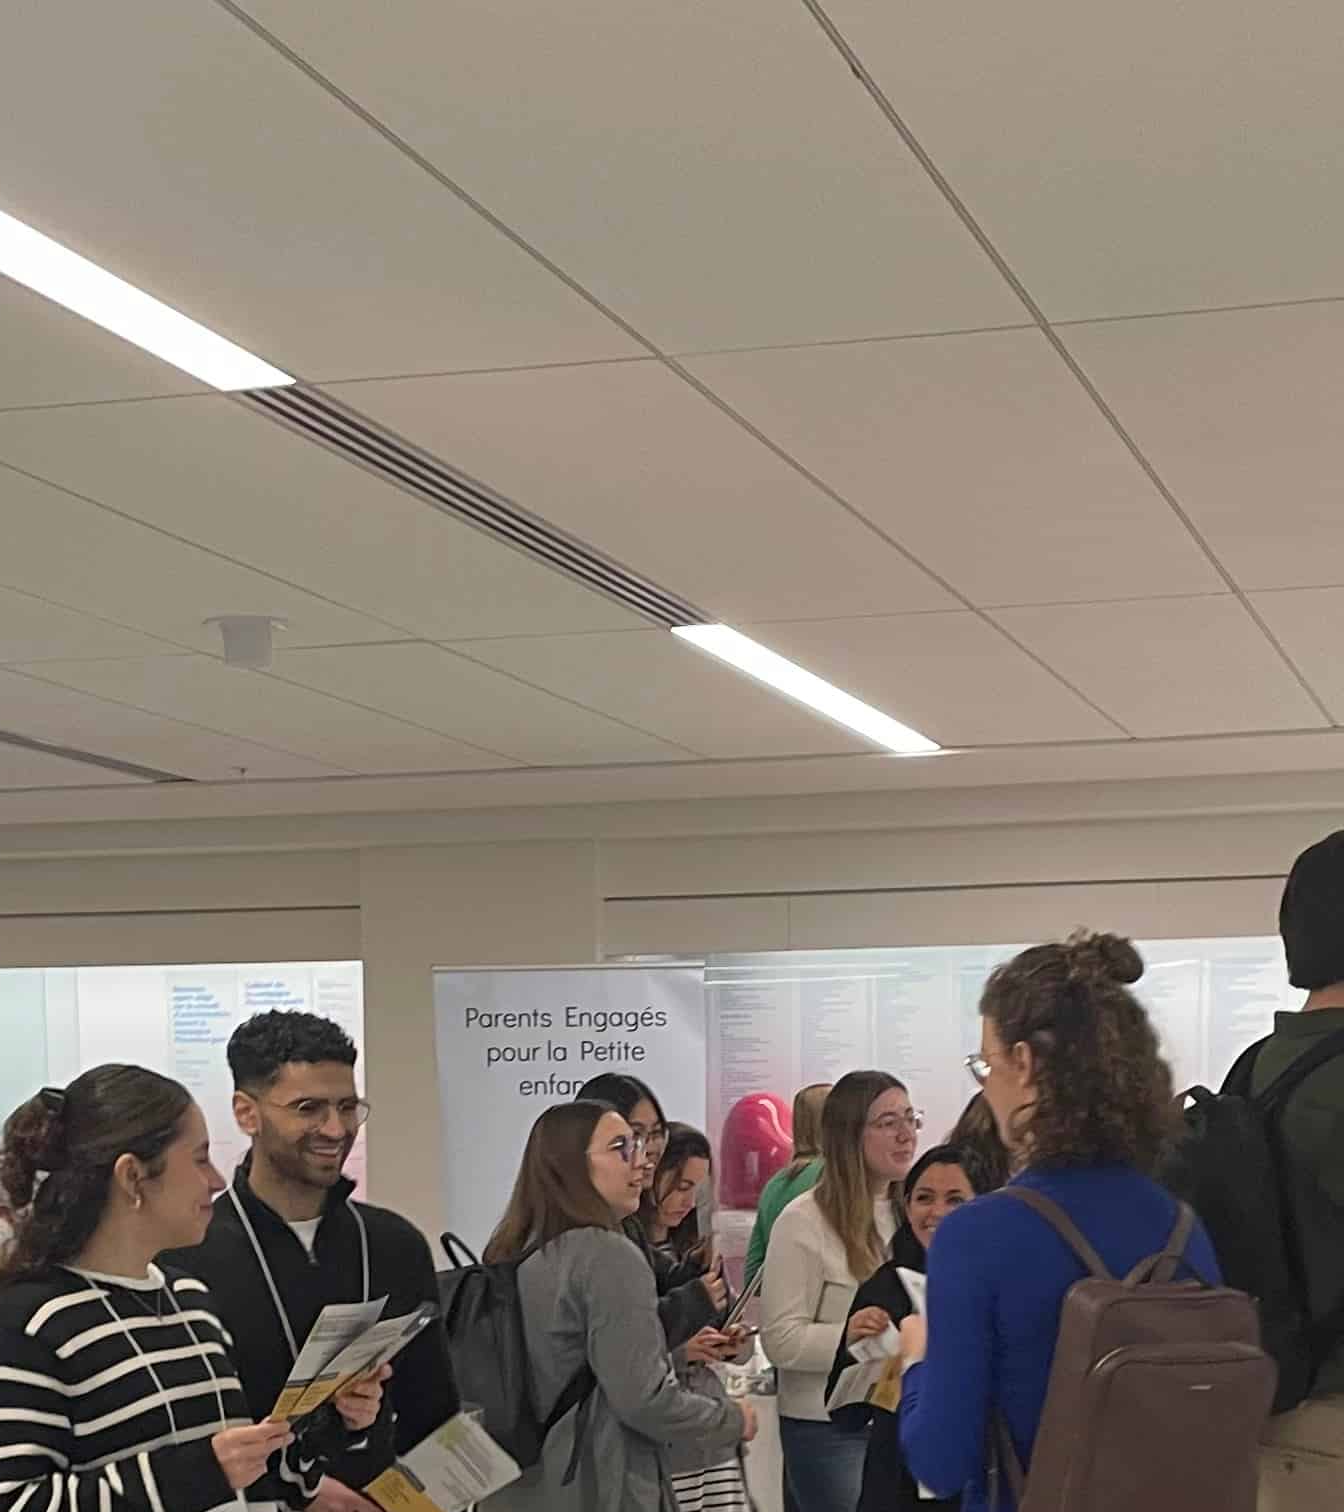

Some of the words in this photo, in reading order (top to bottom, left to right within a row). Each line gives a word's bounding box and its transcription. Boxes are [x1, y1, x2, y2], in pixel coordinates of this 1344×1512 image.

[464, 1006, 553, 1028] Parents
[565, 1005, 667, 1032] Engagés
[487, 1046, 541, 1068] pour
[547, 1040, 567, 1061] la
[581, 1040, 645, 1061] Petite
[519, 1071, 585, 1096] enfan
